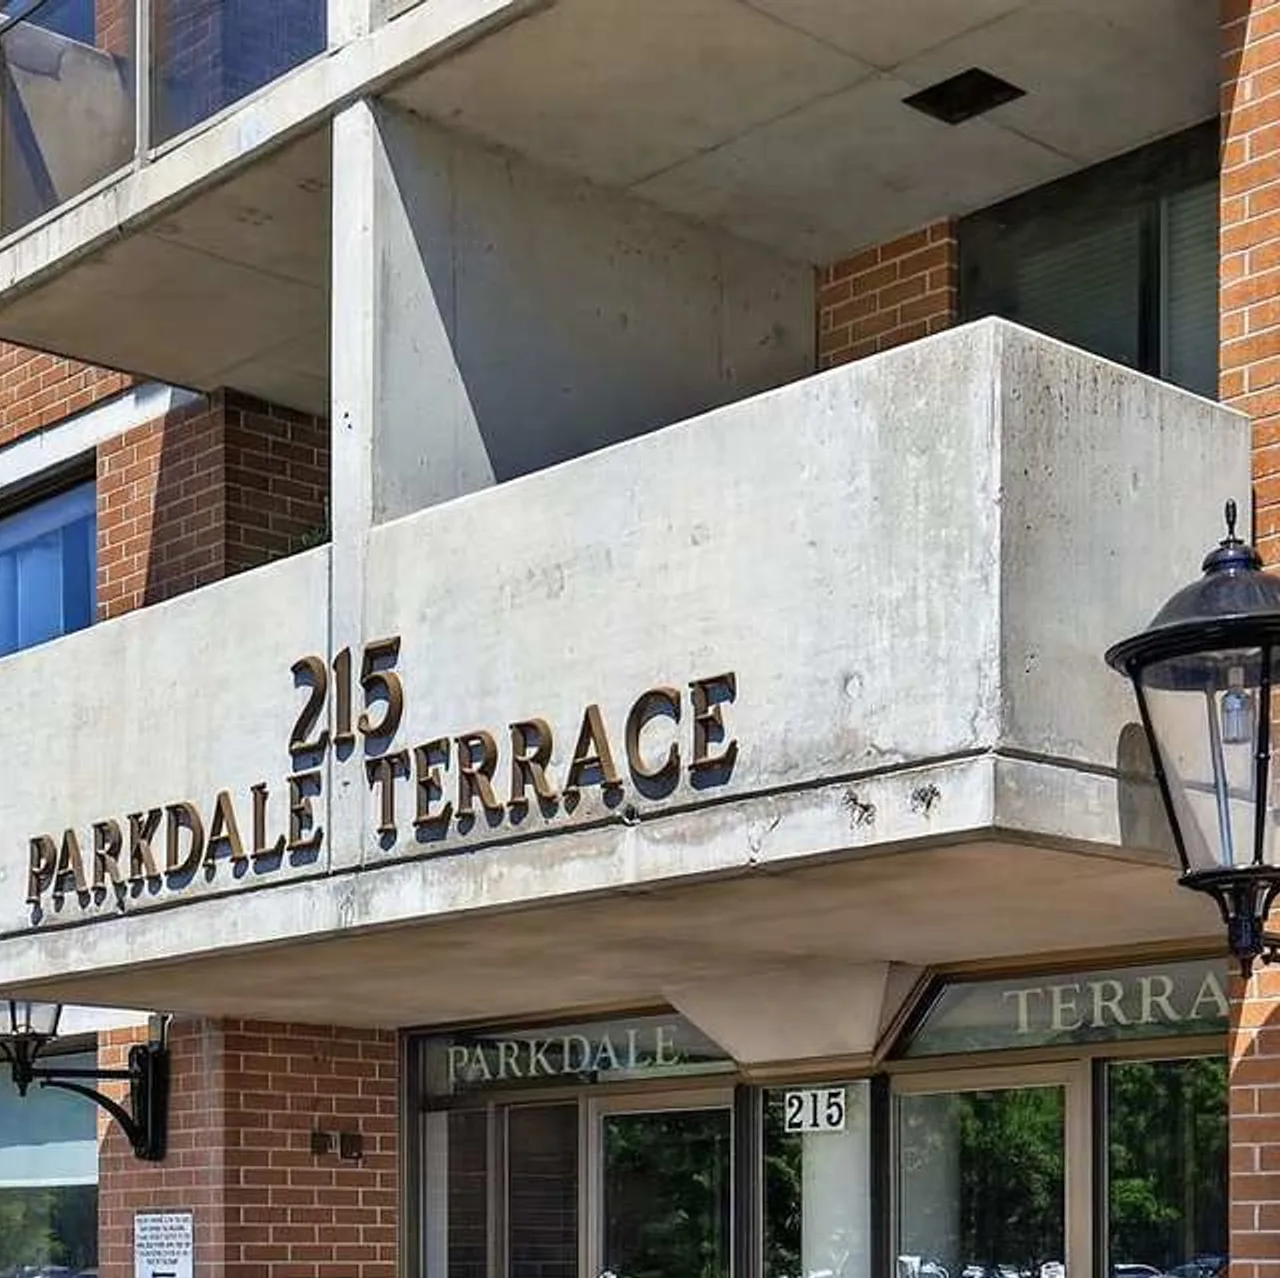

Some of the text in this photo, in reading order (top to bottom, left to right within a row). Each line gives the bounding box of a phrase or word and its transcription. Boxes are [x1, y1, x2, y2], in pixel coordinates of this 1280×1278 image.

[289, 635, 406, 757] 215
[26, 671, 739, 908] PARKDALE TERRACE
[447, 969, 1230, 1083] PARKDALE TERRA
[787, 1091, 844, 1129] 215
